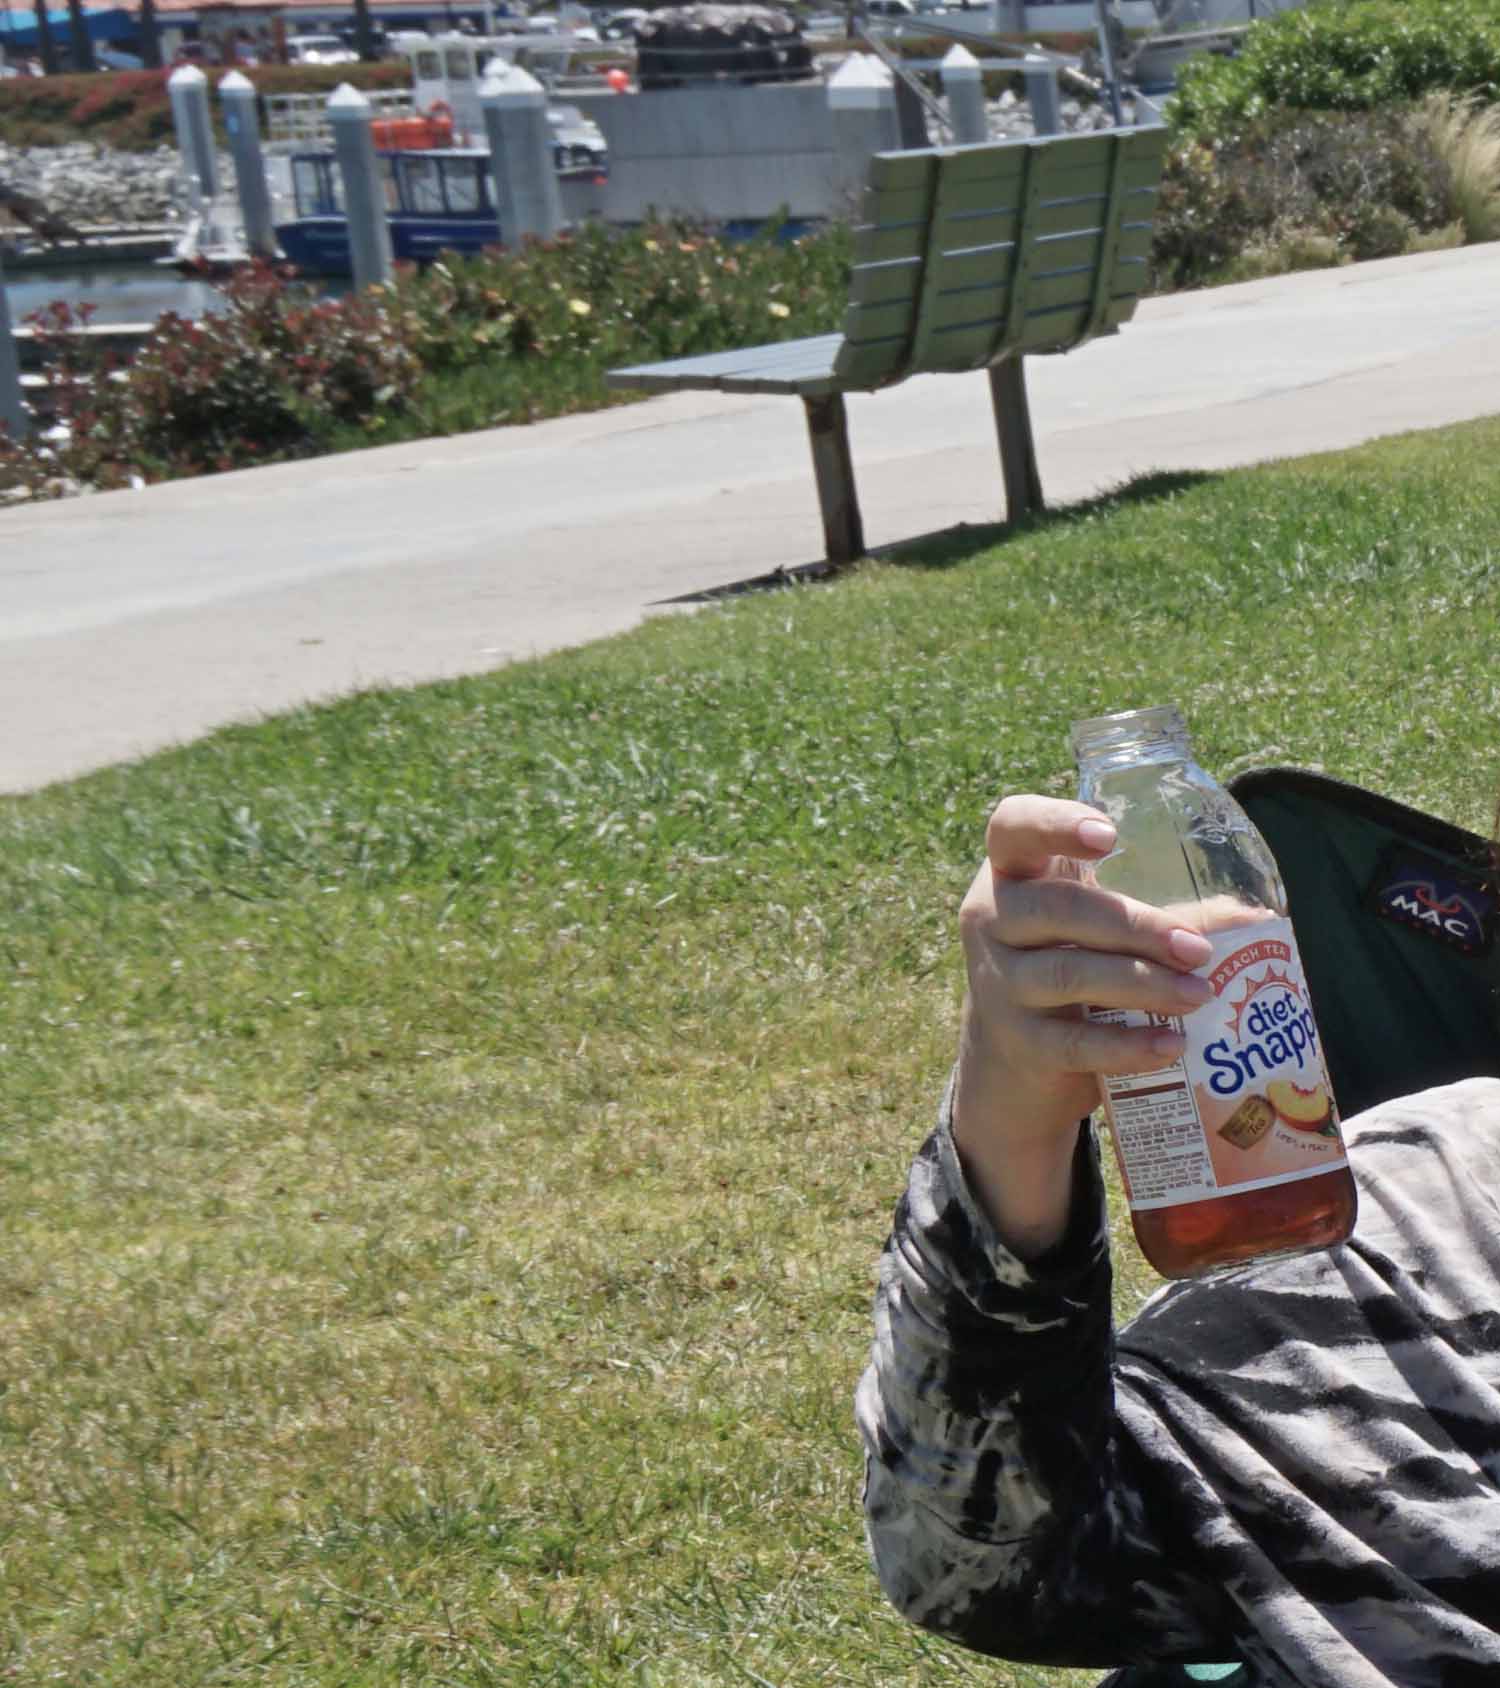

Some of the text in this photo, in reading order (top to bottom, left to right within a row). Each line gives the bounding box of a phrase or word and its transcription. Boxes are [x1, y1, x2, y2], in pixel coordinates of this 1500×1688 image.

[1391, 895, 1469, 937] MAC
[1216, 946, 1259, 985] PEACH
[1247, 990, 1297, 1036] diet
[1203, 1007, 1317, 1095] Snapp
